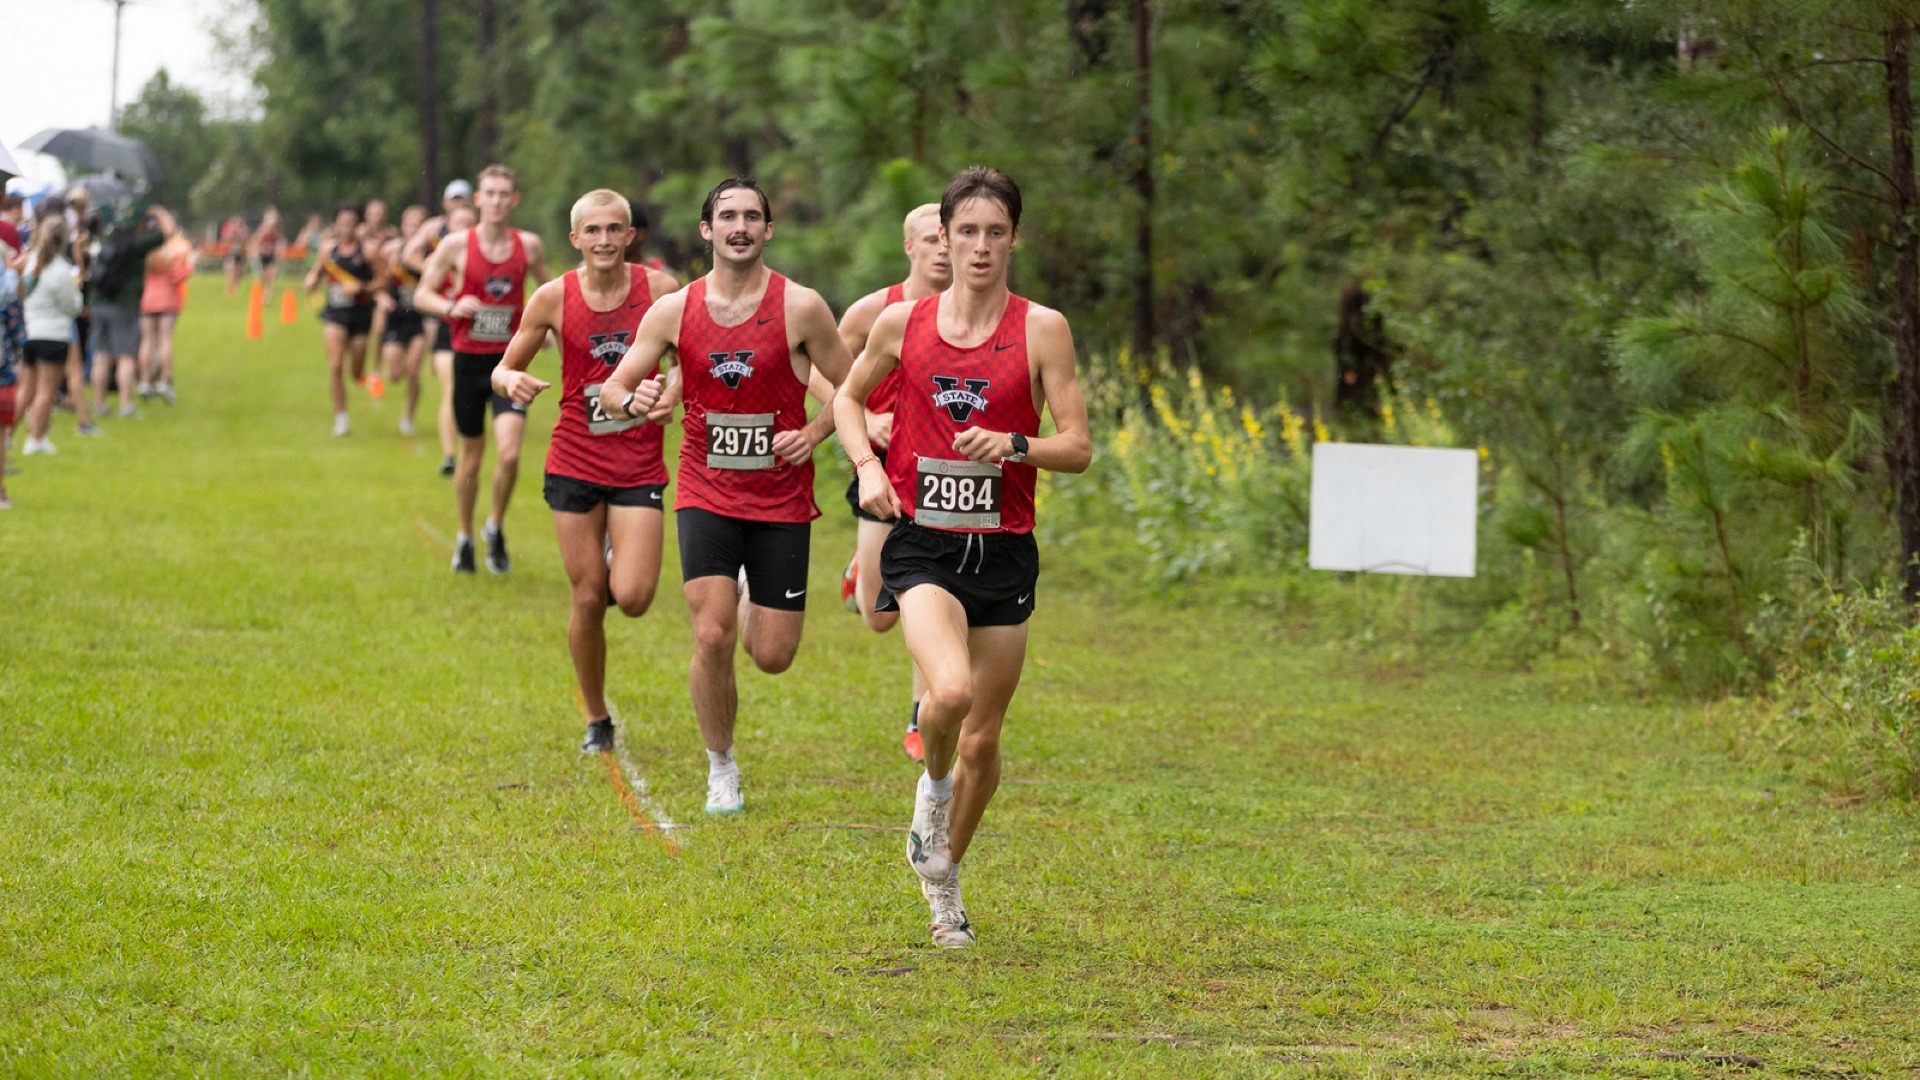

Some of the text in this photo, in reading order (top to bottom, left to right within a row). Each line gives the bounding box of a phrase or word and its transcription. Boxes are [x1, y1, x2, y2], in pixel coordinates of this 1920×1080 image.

[709, 350, 754, 389] V
[717, 363, 746, 373] STATE
[932, 374, 990, 423] V
[942, 392, 979, 405] STATE
[712, 426, 768, 455] 2975
[923, 475, 994, 511] 2984
